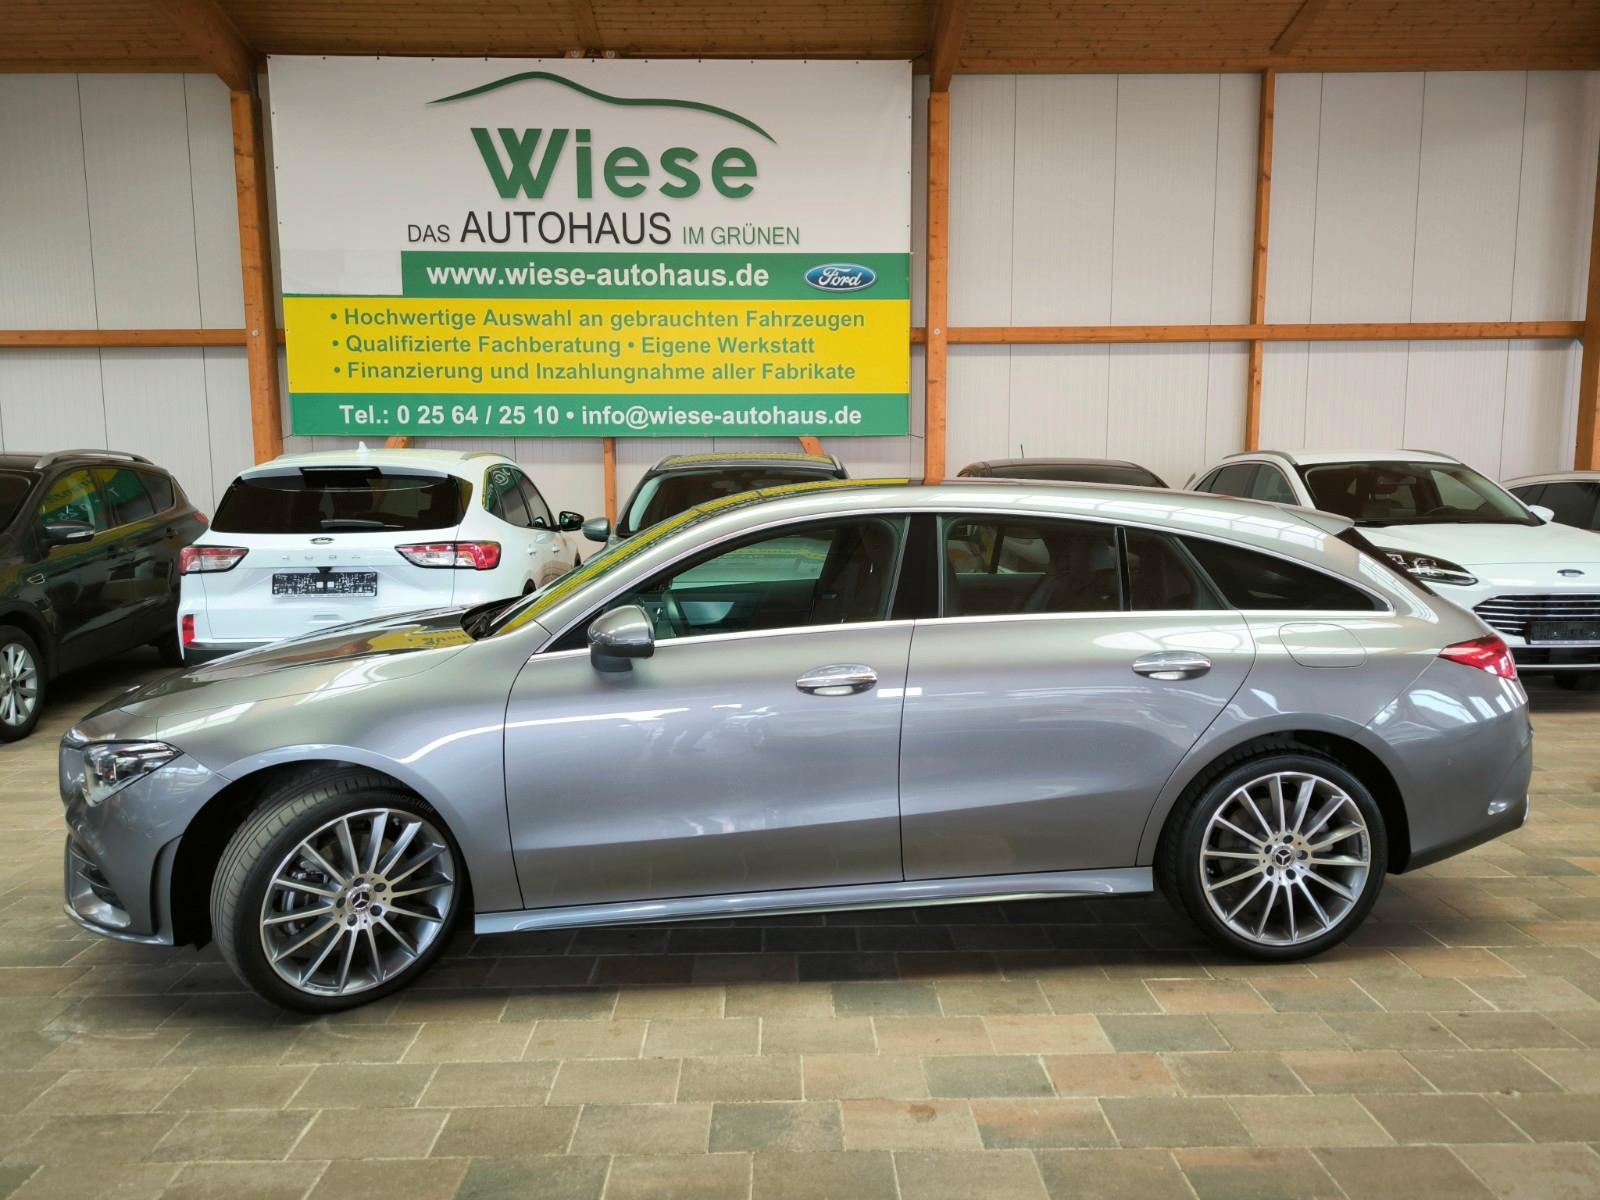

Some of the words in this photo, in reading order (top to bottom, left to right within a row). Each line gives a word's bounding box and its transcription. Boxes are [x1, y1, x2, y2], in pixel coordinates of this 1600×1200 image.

[470, 127, 758, 201] Wiese
[408, 225, 450, 243] DAS
[460, 212, 671, 245] AUTOHAUS
[683, 228, 705, 244] IM
[711, 223, 800, 245] GRÜNEN
[426, 263, 769, 288] www.wiese-autohaus.de
[818, 266, 863, 286] Ford
[344, 307, 476, 330] Hochwertige
[483, 309, 572, 327] Auswahl
[579, 313, 604, 327] an
[610, 310, 739, 332] gebrauchten
[746, 310, 865, 332] Fahrzeugen
[346, 335, 471, 354] Qualifizierte
[478, 335, 621, 357] Fachberatung
[642, 337, 711, 358] Eigene
[718, 337, 815, 354] Werkstatt
[347, 361, 483, 384] Finanzierung
[491, 362, 529, 380] und
[536, 363, 705, 385] Inzahlungnahme
[712, 363, 756, 380] aller
[763, 363, 856, 380] Fabrikate
[339, 405, 388, 424] Tel.:
[397, 406, 410, 424] 0
[417, 406, 445, 424] 25
[451, 406, 479, 425] 64
[499, 406, 526, 424] 25
[534, 406, 559, 425] 10
[582, 405, 862, 430] info@wiese-autohaus.de
